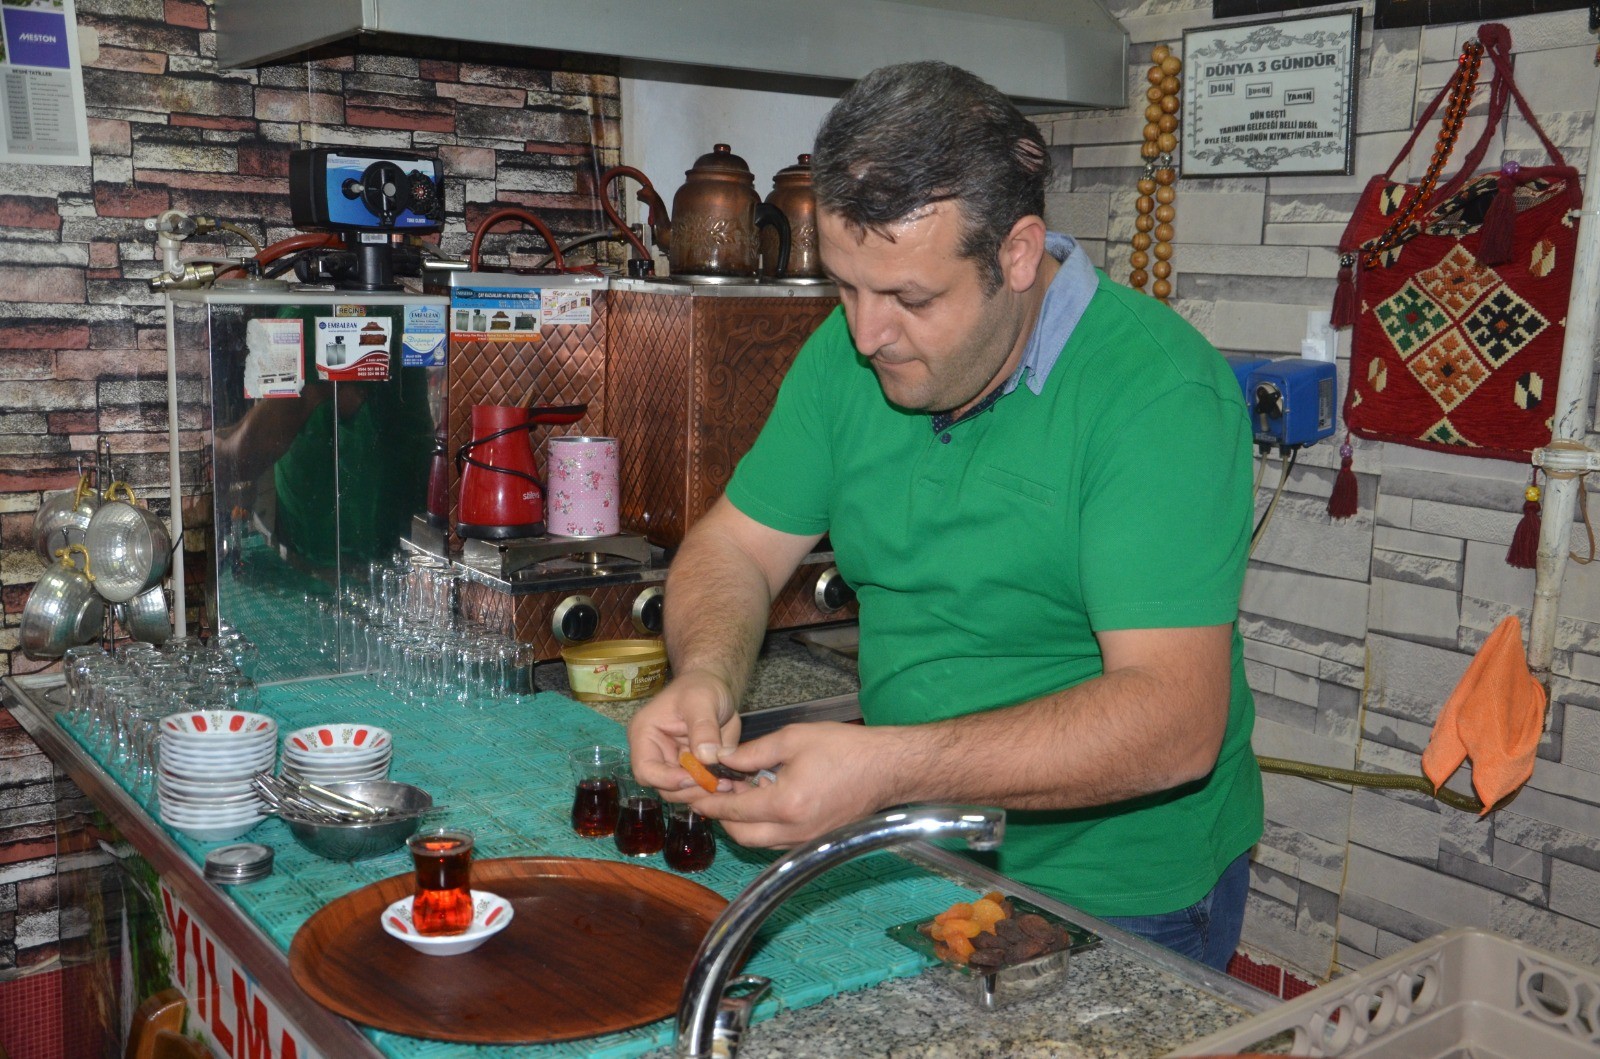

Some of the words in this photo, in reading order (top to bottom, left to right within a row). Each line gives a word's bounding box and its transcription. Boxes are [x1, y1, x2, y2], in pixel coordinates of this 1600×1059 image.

[19, 33, 56, 43] MESTON
[1205, 62, 1253, 78] DÜNYA
[1257, 61, 1267, 73] 3
[1270, 52, 1336, 71] GÜNDÜR
[1287, 91, 1312, 102] YARIN
[1250, 110, 1264, 120] DÜN
[1265, 109, 1286, 120] GEÇTİ
[1219, 124, 1246, 134] YARININ
[1246, 121, 1278, 131] GELECEĞİ
[1279, 120, 1297, 129] BELLİ
[1298, 120, 1318, 129] DEĞİL
[1235, 132, 1268, 142] BUGÜNÜN
[1269, 130, 1305, 141] KIYMETİNİ
[1306, 130, 1334, 139] BİLELİM
[162, 886, 298, 1059] YILM
